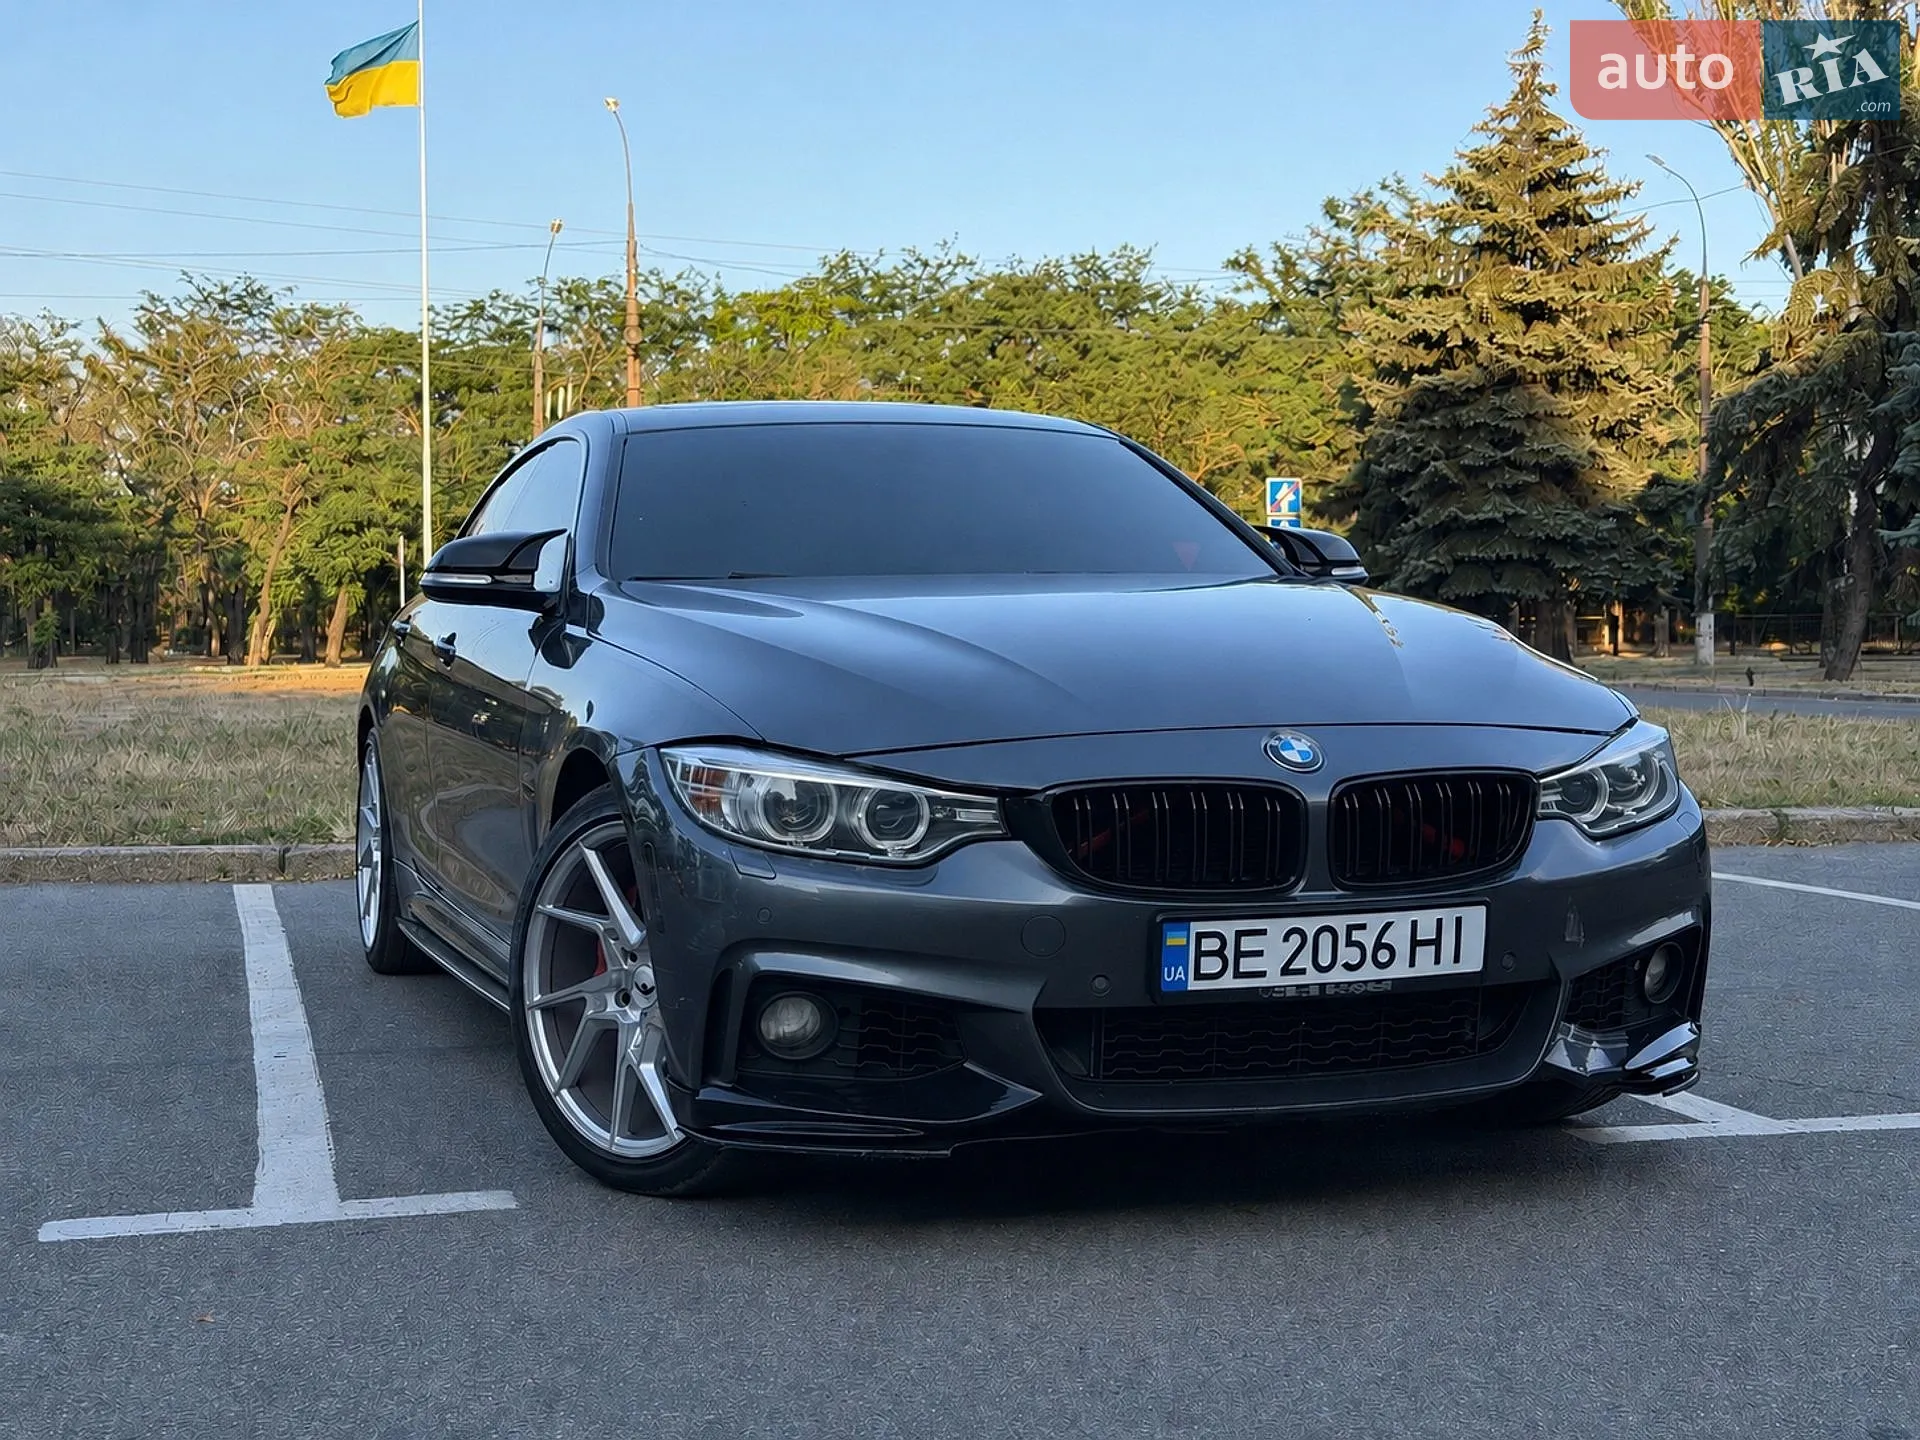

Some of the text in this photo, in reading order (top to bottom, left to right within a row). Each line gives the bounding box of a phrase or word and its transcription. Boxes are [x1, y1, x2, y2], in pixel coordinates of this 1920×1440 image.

[1194, 916, 1463, 981] BE 2056 HI
[1164, 965, 1186, 982] UA
